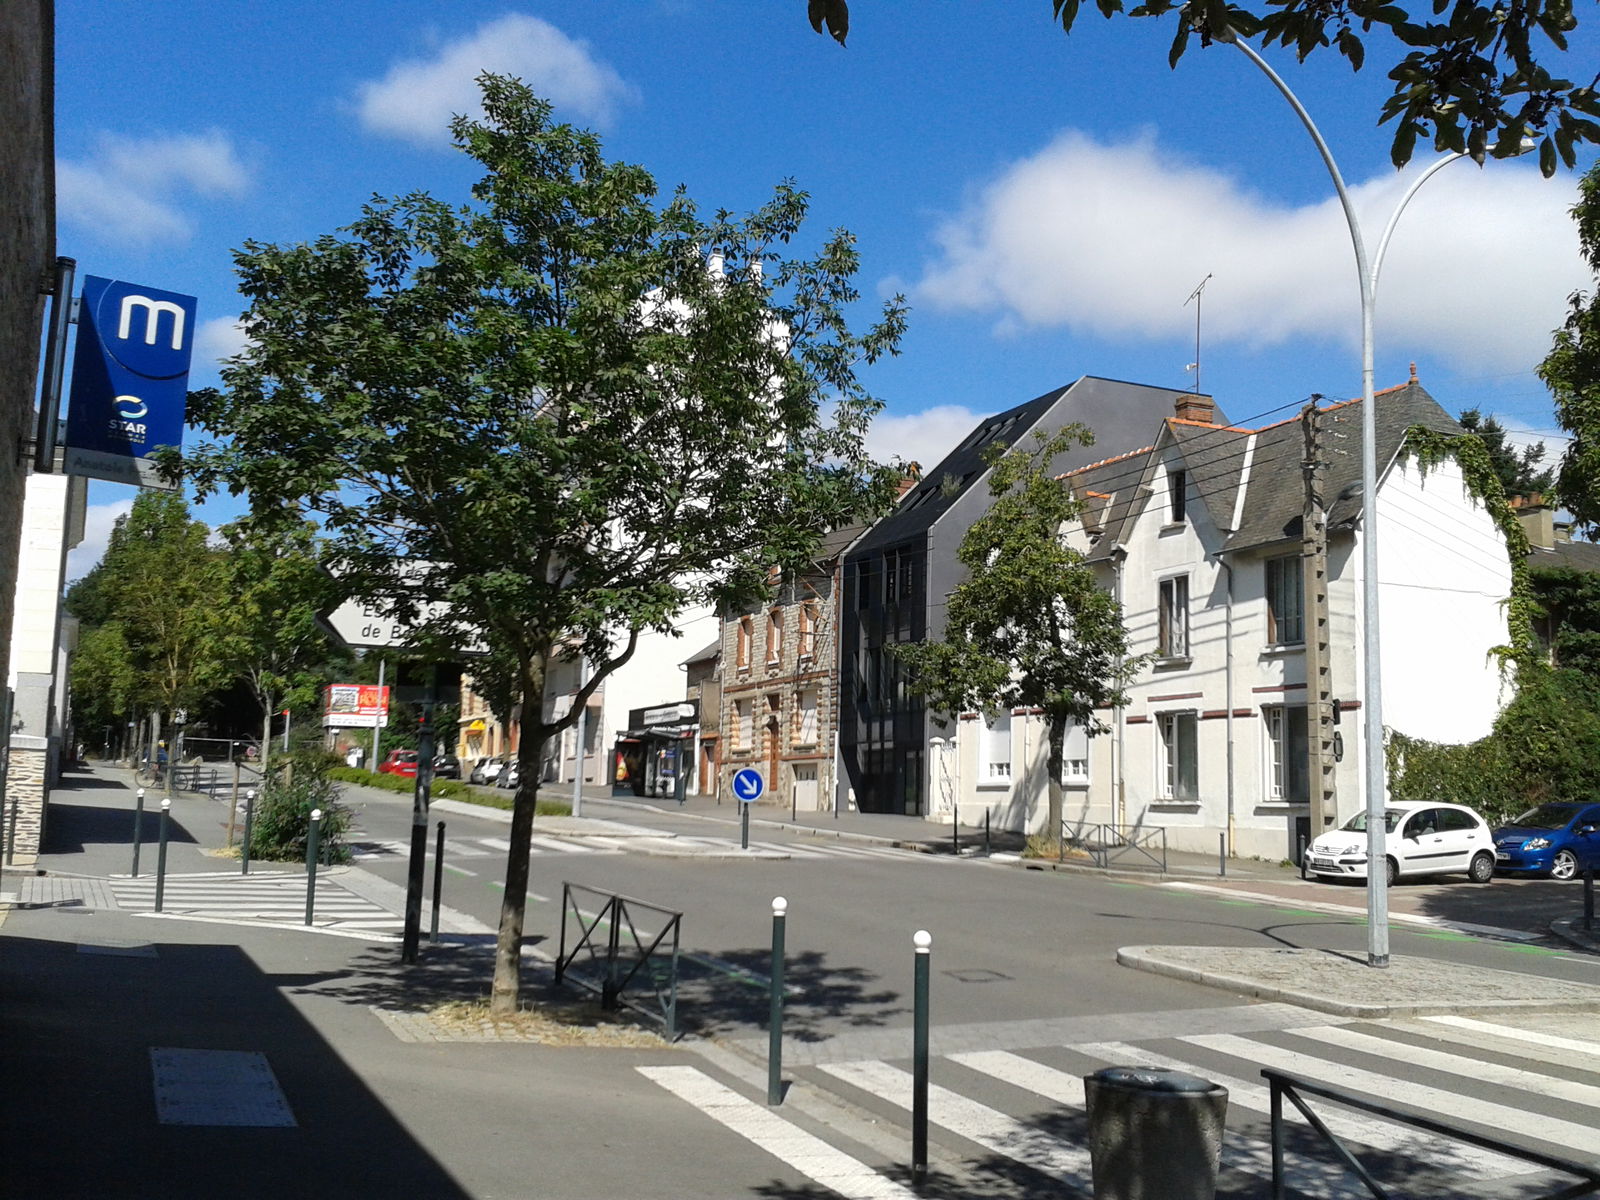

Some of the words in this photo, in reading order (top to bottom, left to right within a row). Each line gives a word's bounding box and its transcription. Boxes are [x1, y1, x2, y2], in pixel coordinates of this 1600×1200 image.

[118, 294, 186, 351] m
[108, 419, 147, 435] STAR
[360, 624, 381, 639] de
